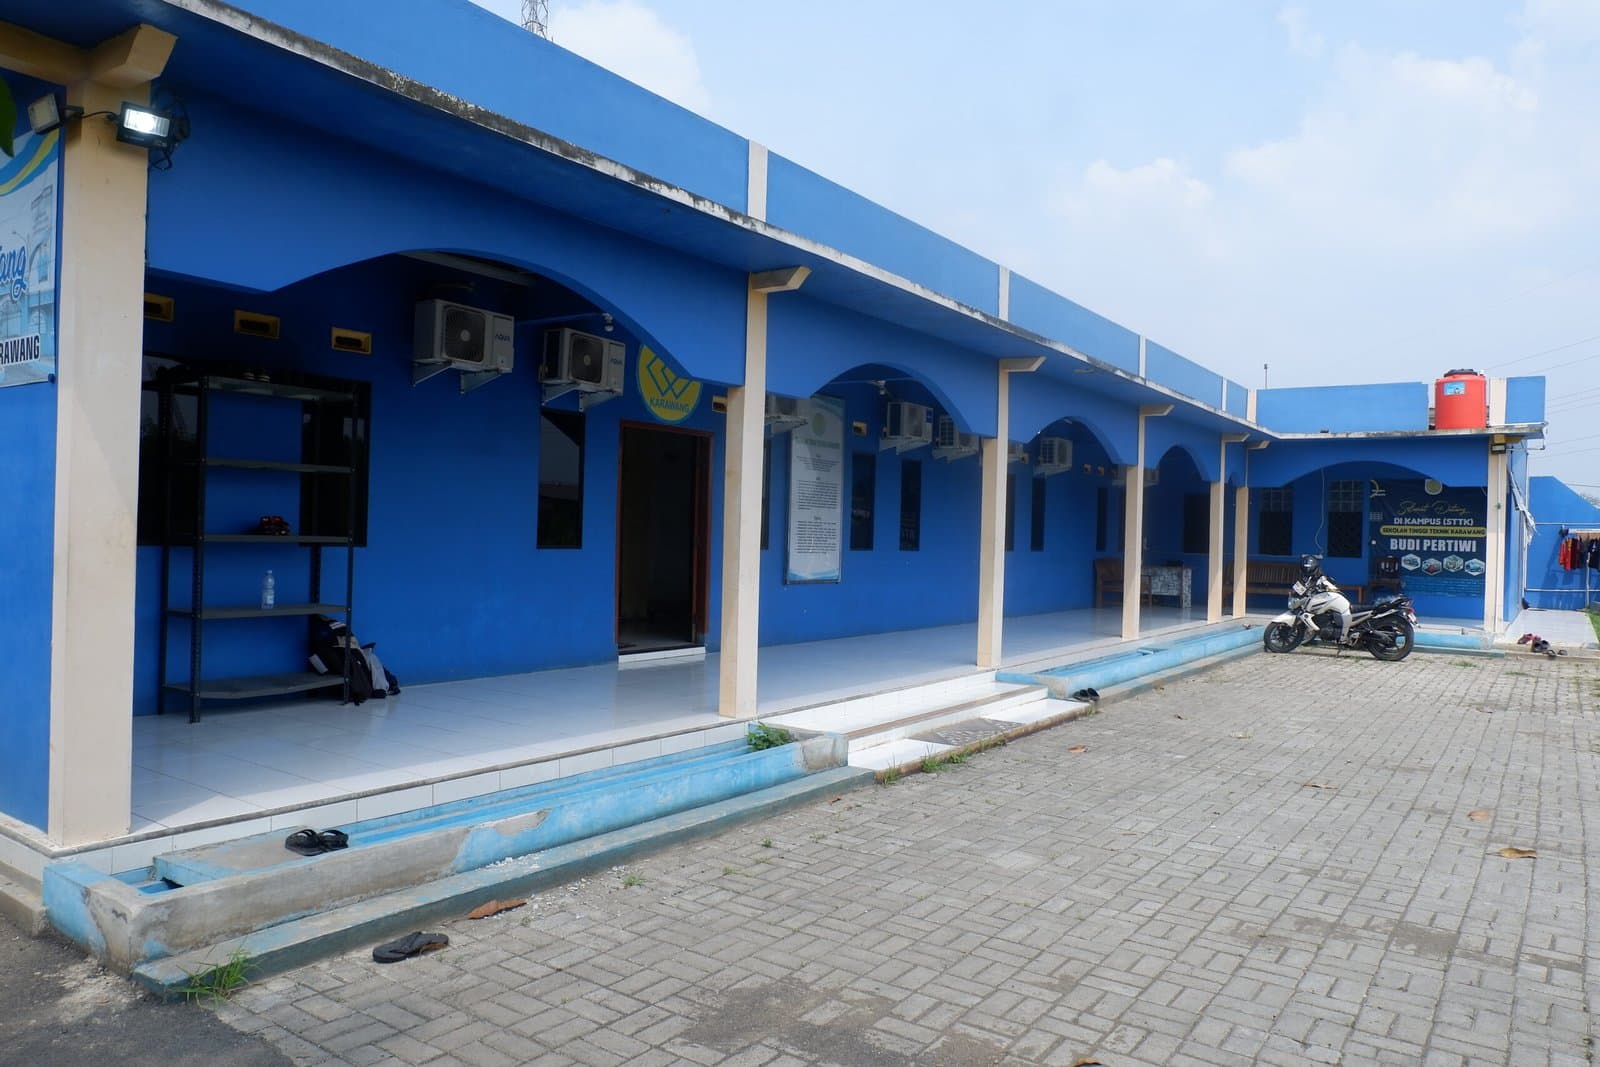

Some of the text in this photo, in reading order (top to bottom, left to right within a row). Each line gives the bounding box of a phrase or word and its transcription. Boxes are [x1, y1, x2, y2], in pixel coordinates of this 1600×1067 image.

[1404, 518, 1441, 526] KAMPUS
[1443, 518, 1474, 526] (STTK)
[1390, 539, 1477, 552] BUDI PERTIWI
